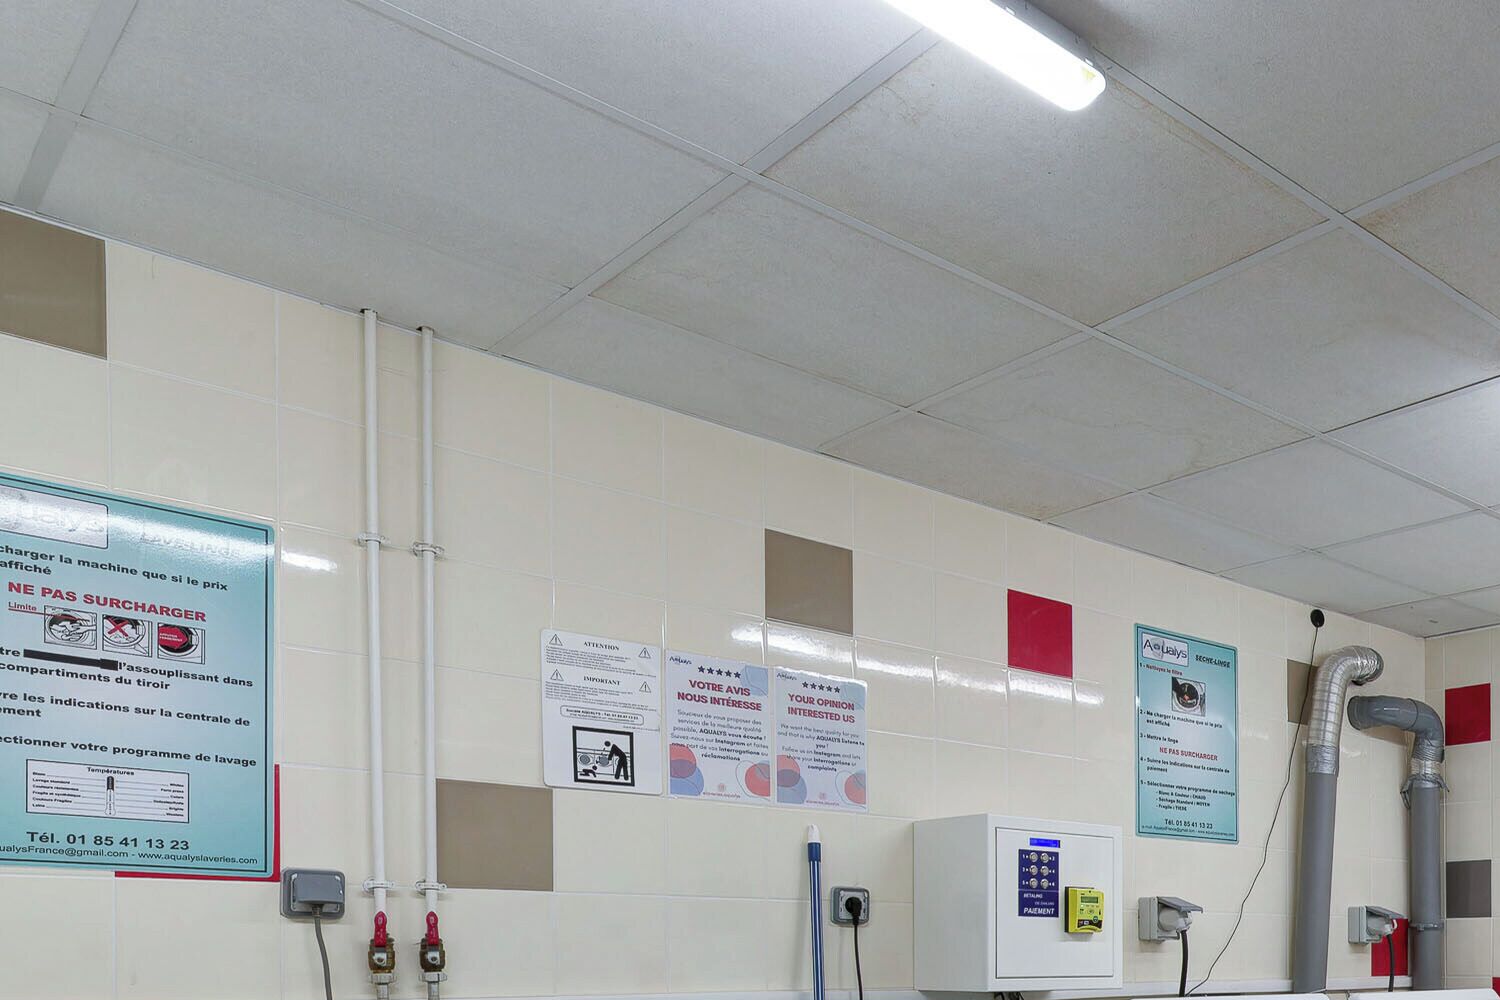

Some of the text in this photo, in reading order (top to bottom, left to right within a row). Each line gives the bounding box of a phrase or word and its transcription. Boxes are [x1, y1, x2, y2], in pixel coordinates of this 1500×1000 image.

[0, 560, 52, 575] affiché
[0, 545, 228, 591] charger la machine que si le prix
[8, 581, 206, 622] NE PAS SURCHARGER
[8, 601, 37, 612] Limite
[583, 641, 620, 651] ATTENTION
[1143, 639, 1188, 659] Aqualys
[0, 661, 170, 690] compartiments du tiroir
[118, 660, 219, 683] l'assouplissant
[223, 676, 253, 687] dans
[583, 675, 621, 686] IMPORTANT
[688, 679, 751, 697] VOTRE AVIS
[677, 691, 762, 711] NOUS INTÉRESSE
[787, 692, 855, 711] YOUR OPINION
[23, 692, 45, 703] les
[50, 695, 130, 713] indications
[134, 706, 156, 716] sur
[160, 708, 172, 718] la
[176, 711, 231, 724] centrale
[234, 718, 250, 727] de
[787, 706, 856, 724] INTERESTED US
[699, 727, 727, 737] AQUALYS
[743, 732, 763, 741] écoute
[815, 735, 841, 744] AQUALYS
[714, 737, 745, 747] Instagram
[71, 741, 108, 753] votre
[112, 745, 191, 760] programme
[195, 752, 211, 762] de
[215, 755, 257, 767] lavage
[701, 752, 741, 762] réclamations
[813, 750, 841, 759] Instagram
[1159, 746, 1218, 761] NE PAS SURCHARGER
[87, 766, 135, 776] Températures
[807, 765, 837, 773] complaints
[26, 831, 190, 851] Tél. 01 85 41 13 23
[138, 851, 258, 865] www.aqualyslaveries.com
[1023, 907, 1055, 915] PAIEMENT
